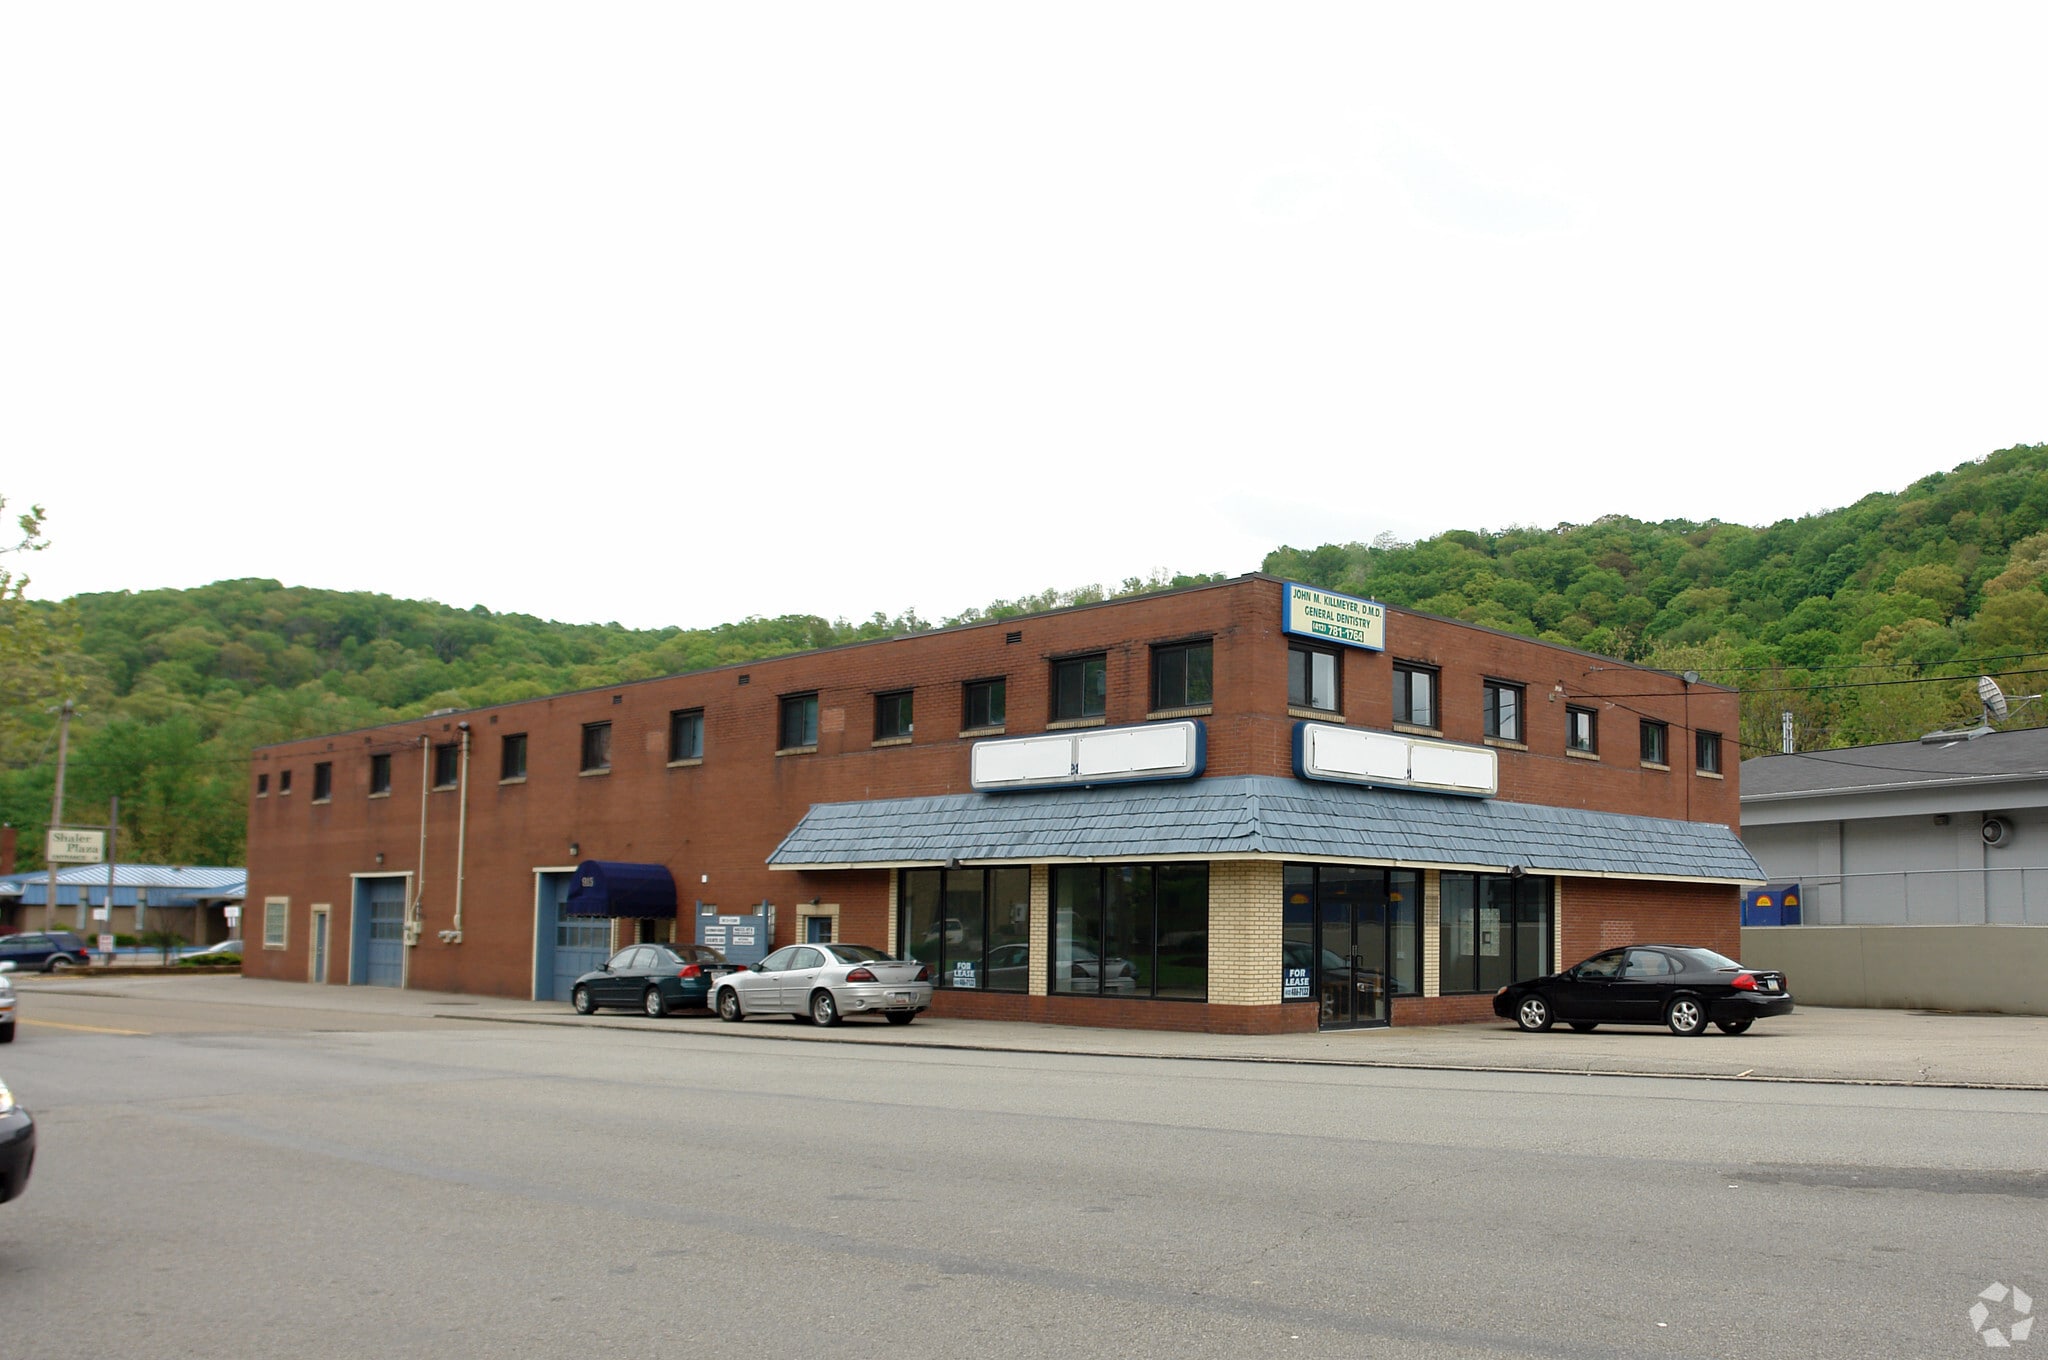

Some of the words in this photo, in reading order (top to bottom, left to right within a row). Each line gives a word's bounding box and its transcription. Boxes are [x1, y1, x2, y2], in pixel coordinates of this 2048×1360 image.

[1293, 589, 1311, 601] JOHN
[1313, 593, 1321, 604] M.
[1324, 596, 1360, 614] KILLMEYER,
[1362, 605, 1382, 618] D.M.D.
[1305, 606, 1334, 621] GENERAL
[1336, 612, 1371, 629] DENTISTRY
[1328, 625, 1363, 641] 781-1764
[53, 833, 92, 843] Shaler
[66, 843, 98, 853] Plaza
[581, 877, 594, 887] 915
[957, 962, 971, 970] FOR
[954, 970, 975, 978] LEASE
[1289, 969, 1306, 977] FOR
[1285, 978, 1310, 986] LEASE
